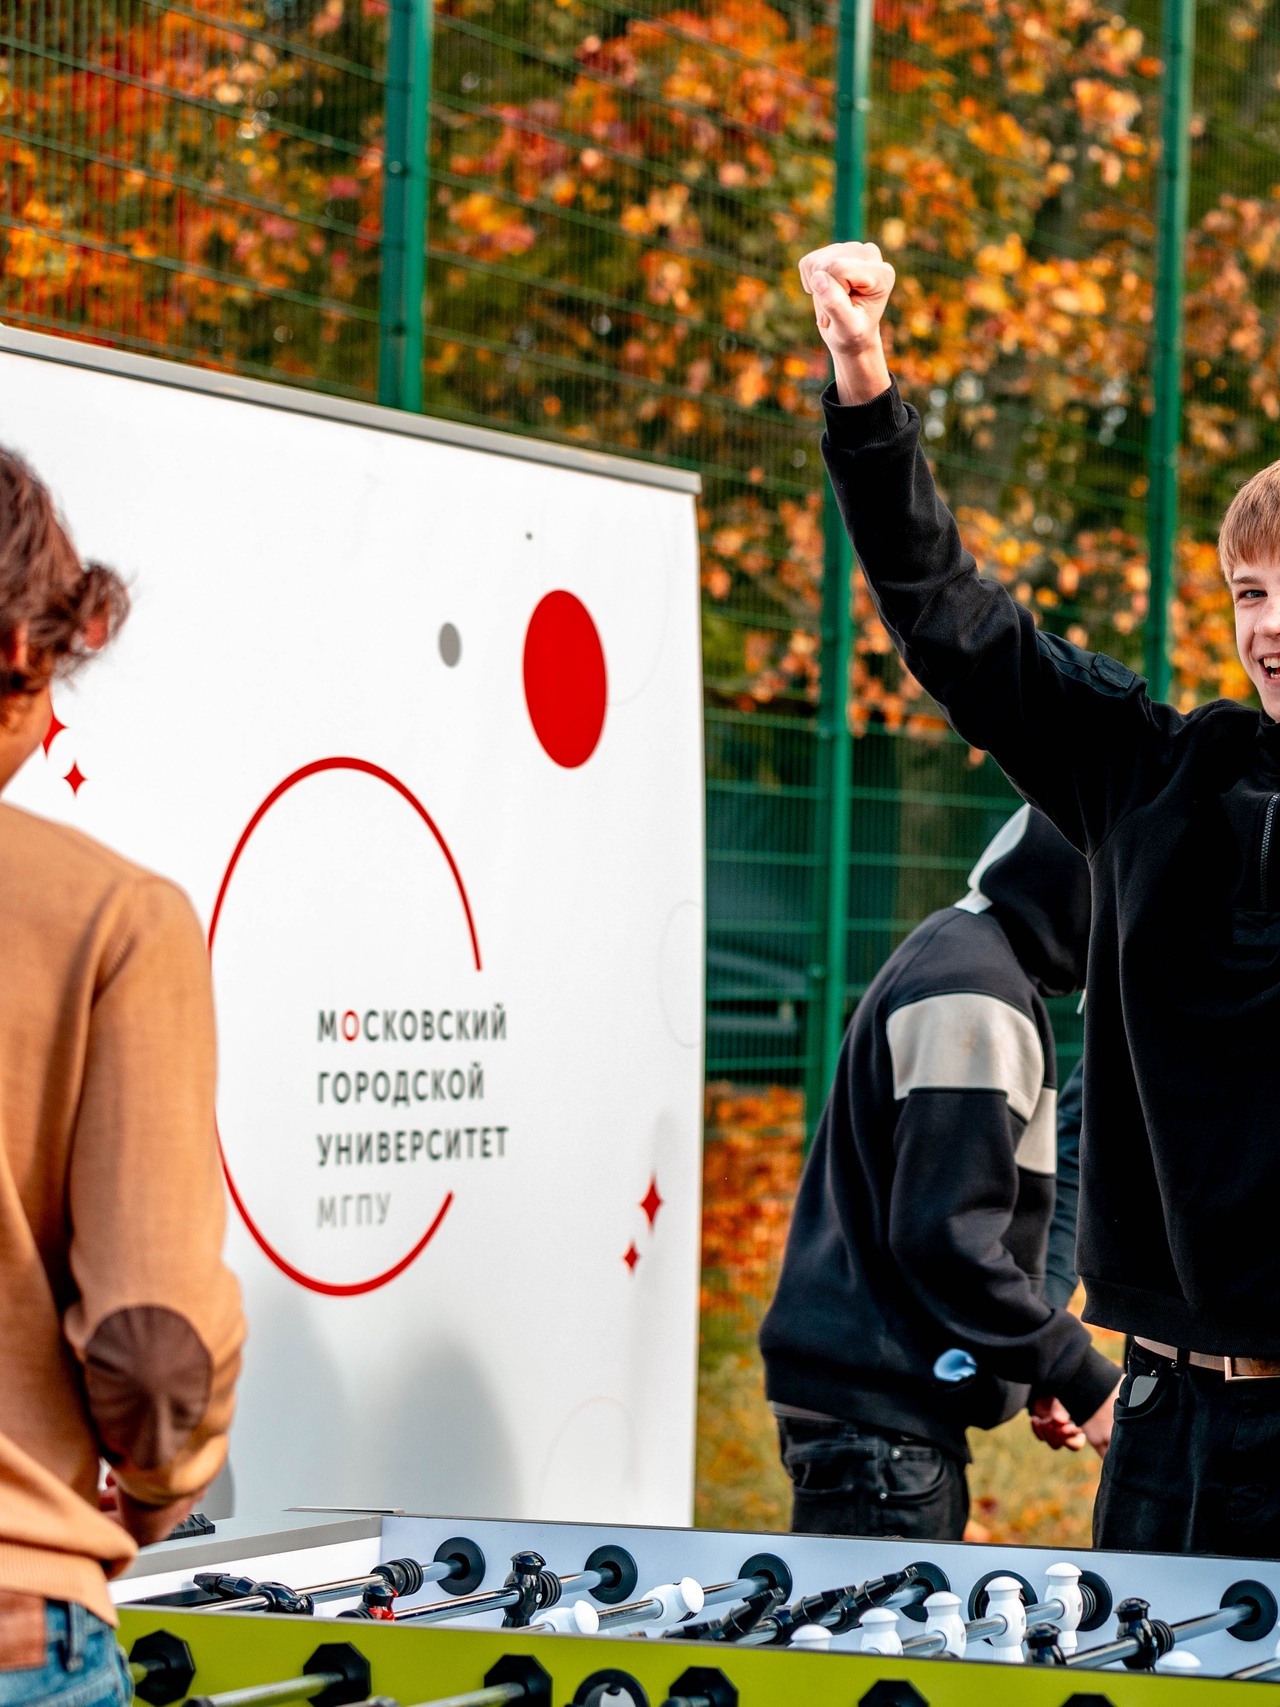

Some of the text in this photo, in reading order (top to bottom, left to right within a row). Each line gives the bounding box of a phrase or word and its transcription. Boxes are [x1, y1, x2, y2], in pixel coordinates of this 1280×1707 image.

[317, 1003, 507, 1042] МОСКОВСКИЙ
[317, 1062, 484, 1107] ГОРОДСКОЙ
[316, 1126, 509, 1166] УНИВЕРСИТЕТ
[316, 1192, 391, 1228] МГПУ
